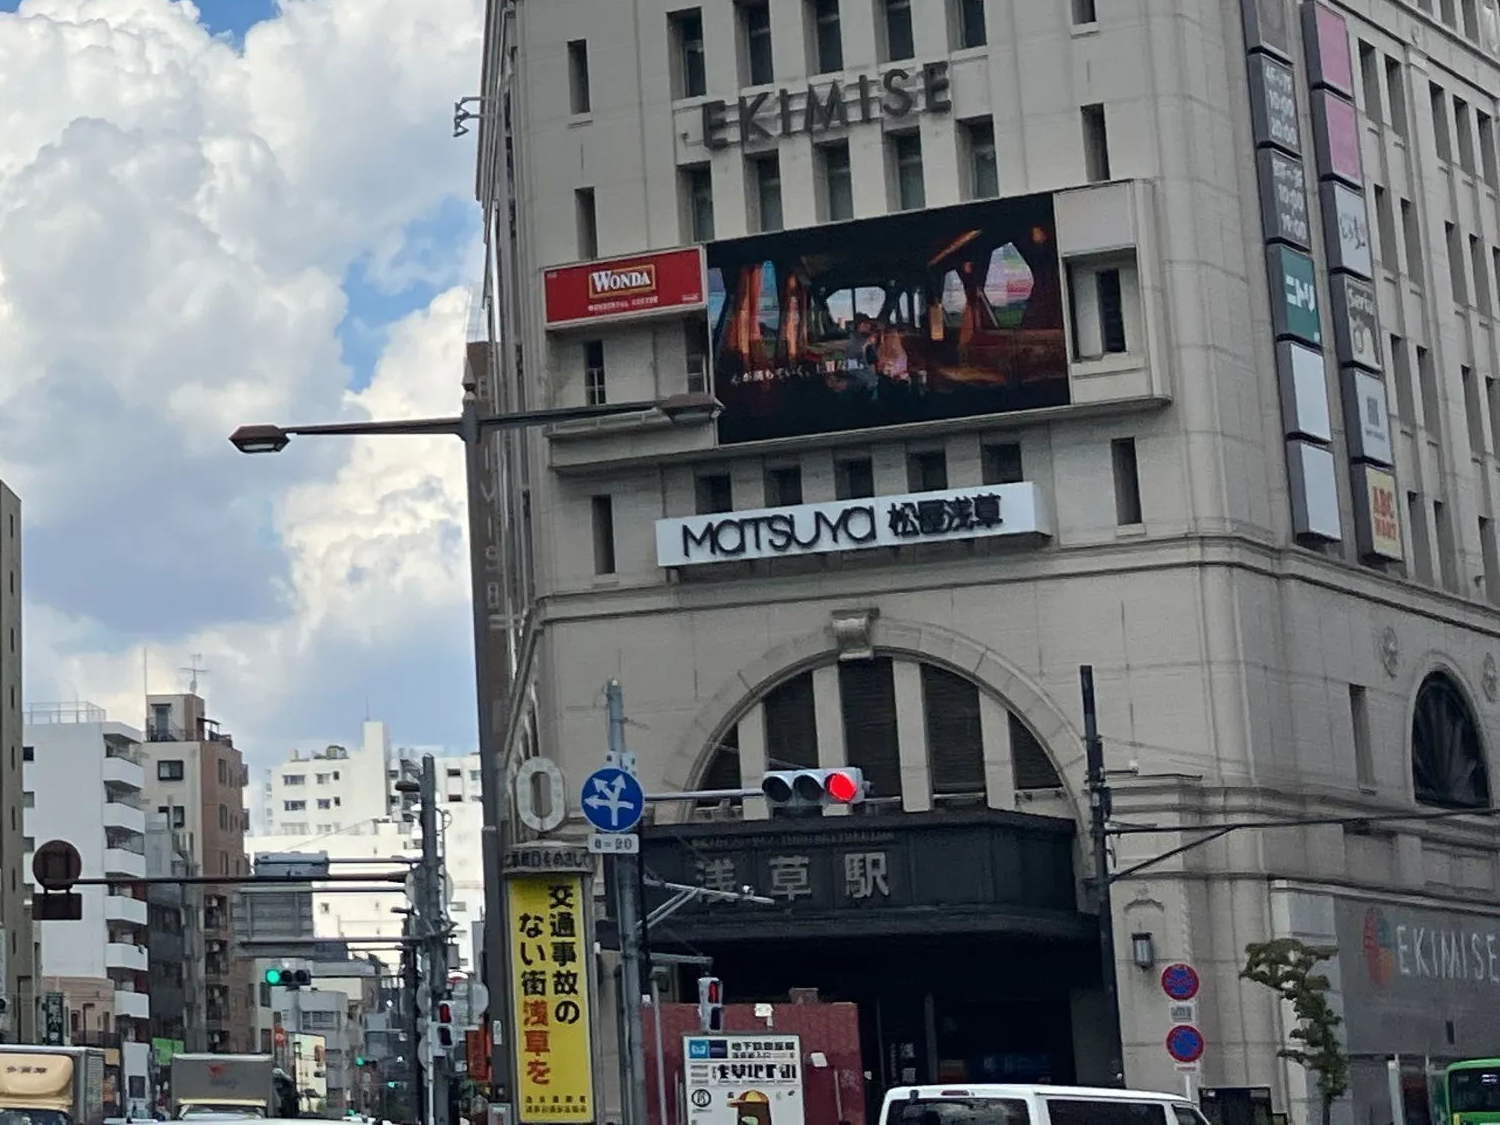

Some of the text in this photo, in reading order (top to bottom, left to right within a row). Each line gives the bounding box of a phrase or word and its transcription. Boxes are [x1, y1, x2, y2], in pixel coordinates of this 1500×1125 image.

[701, 60, 953, 153] EKIMISE
[592, 269, 652, 293] WONDA
[887, 491, 1004, 538] 松屋浅草
[695, 851, 890, 904] 浅草駅
[548, 885, 581, 1025] 交通事故の
[1396, 925, 1500, 983] EKIMISE
[519, 913, 550, 1086] ない街浅草を
